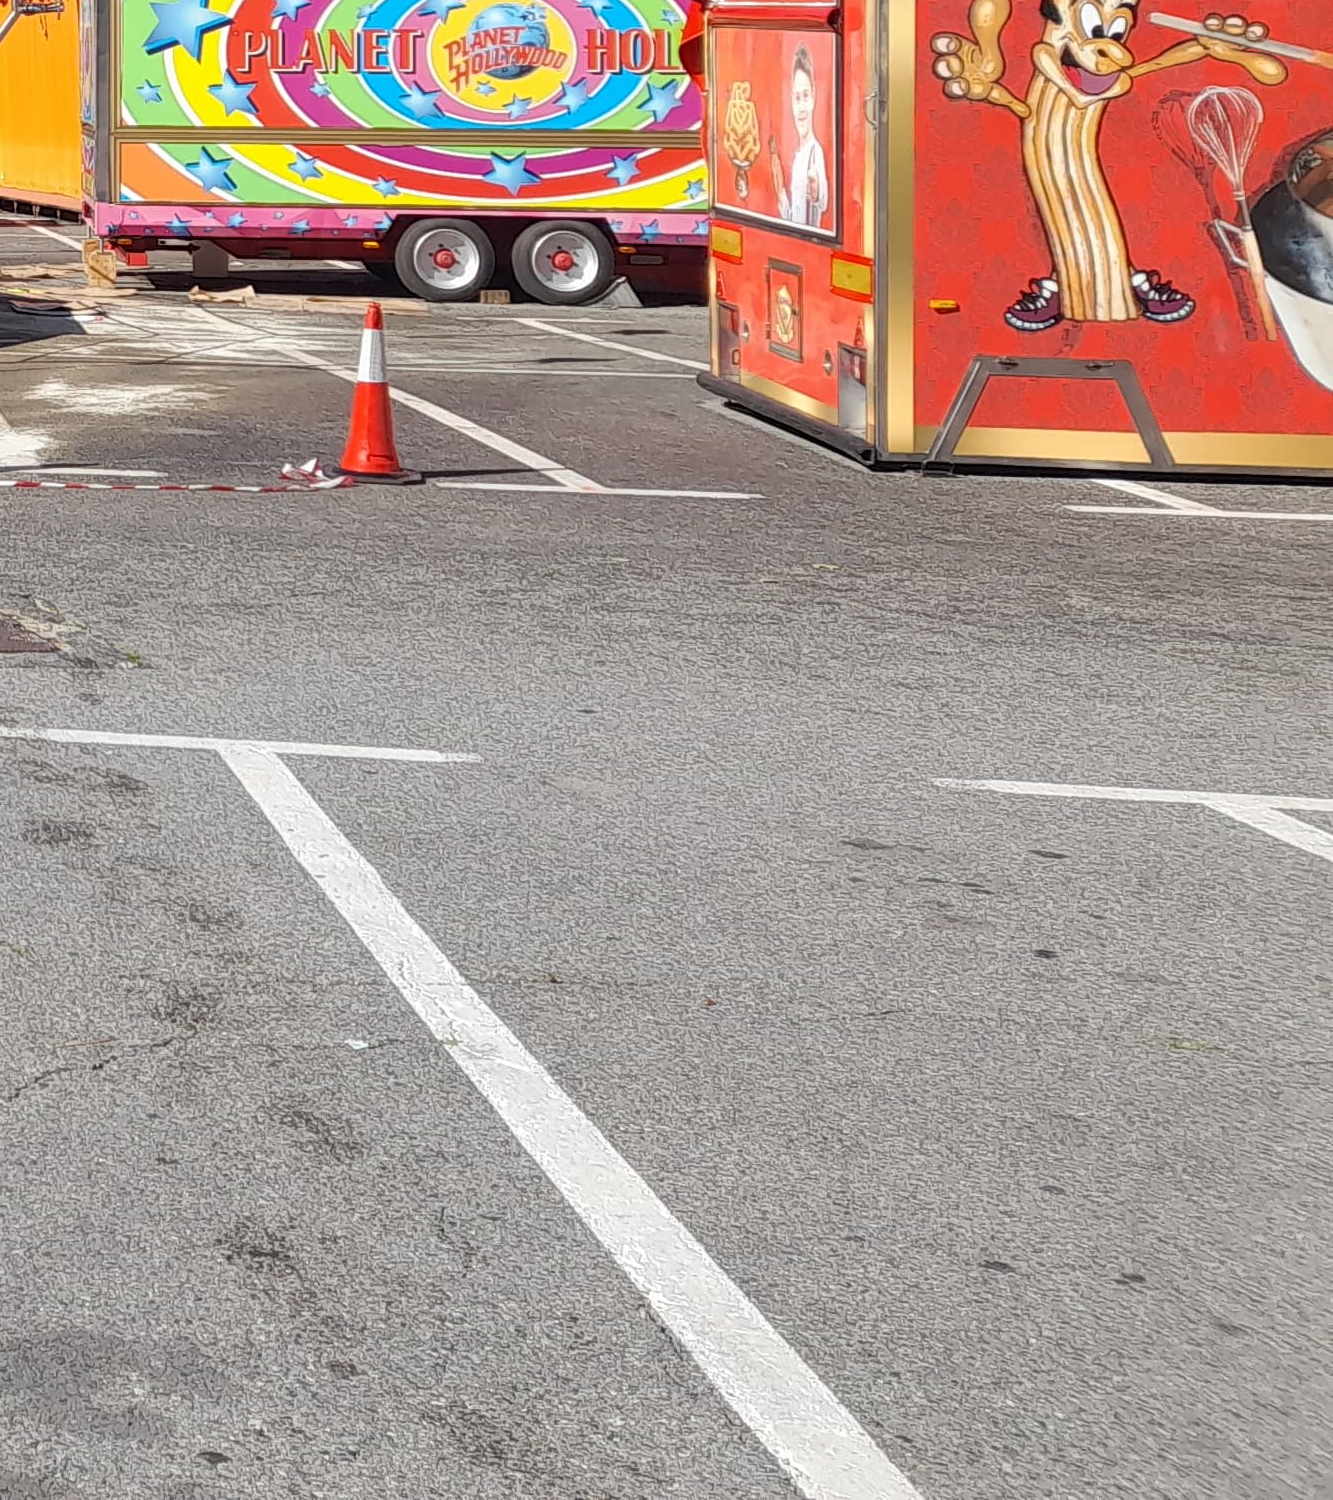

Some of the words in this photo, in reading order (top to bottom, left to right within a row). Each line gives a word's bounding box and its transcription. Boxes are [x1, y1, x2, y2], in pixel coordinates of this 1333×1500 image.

[236, 29, 423, 74] PLANET
[443, 26, 527, 72] PLANET
[450, 45, 568, 93] HOLLYWOOD
